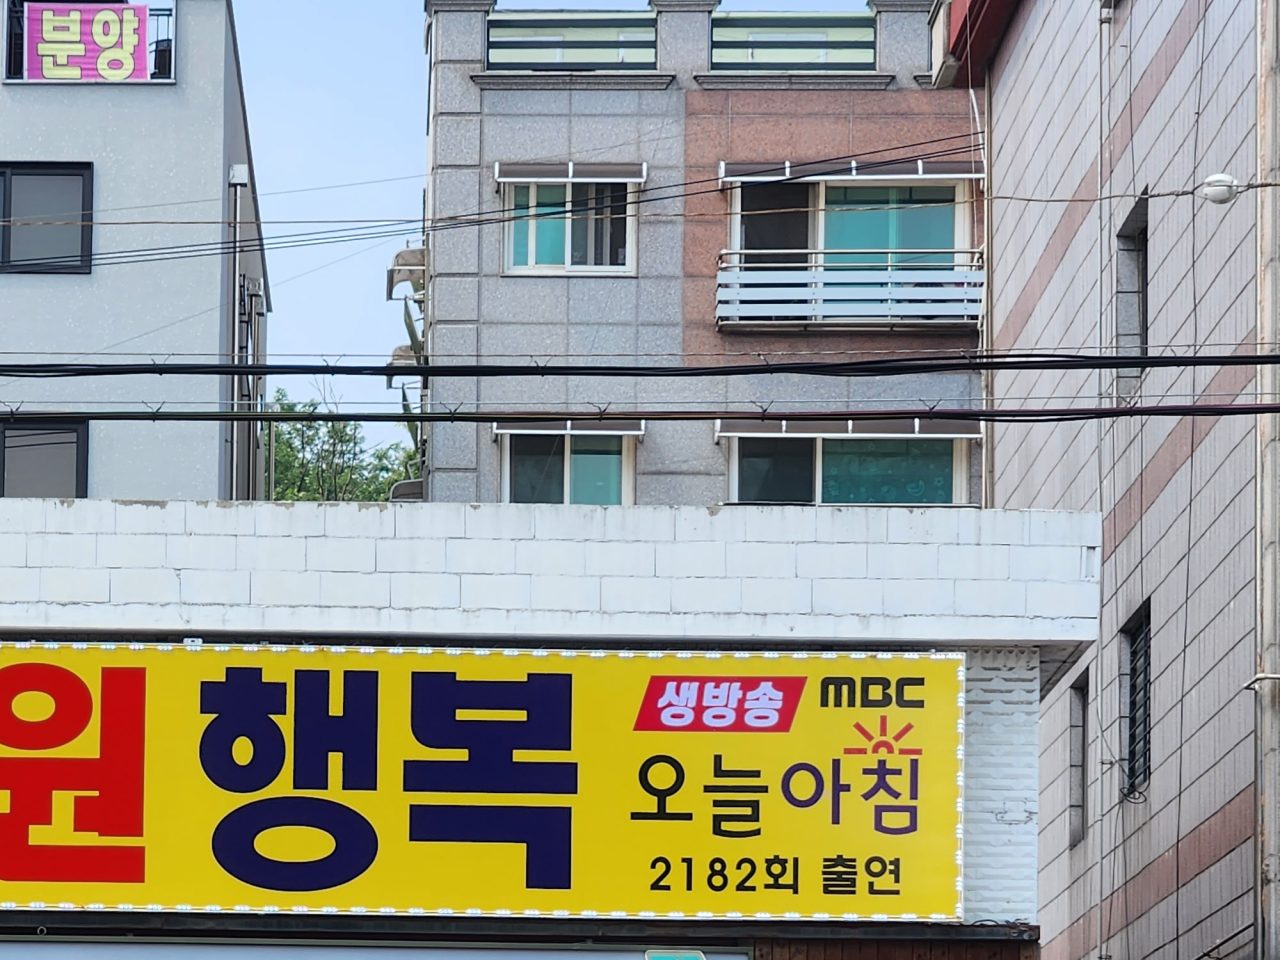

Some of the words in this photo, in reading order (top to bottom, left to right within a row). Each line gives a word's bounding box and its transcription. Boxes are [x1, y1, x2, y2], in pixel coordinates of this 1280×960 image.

[37, 8, 140, 81] 분양
[657, 681, 784, 727] 생방송
[820, 676, 925, 708] MBC
[199, 667, 578, 892] 행복
[649, 855, 799, 895] 2182회
[821, 854, 900, 895] 출연
